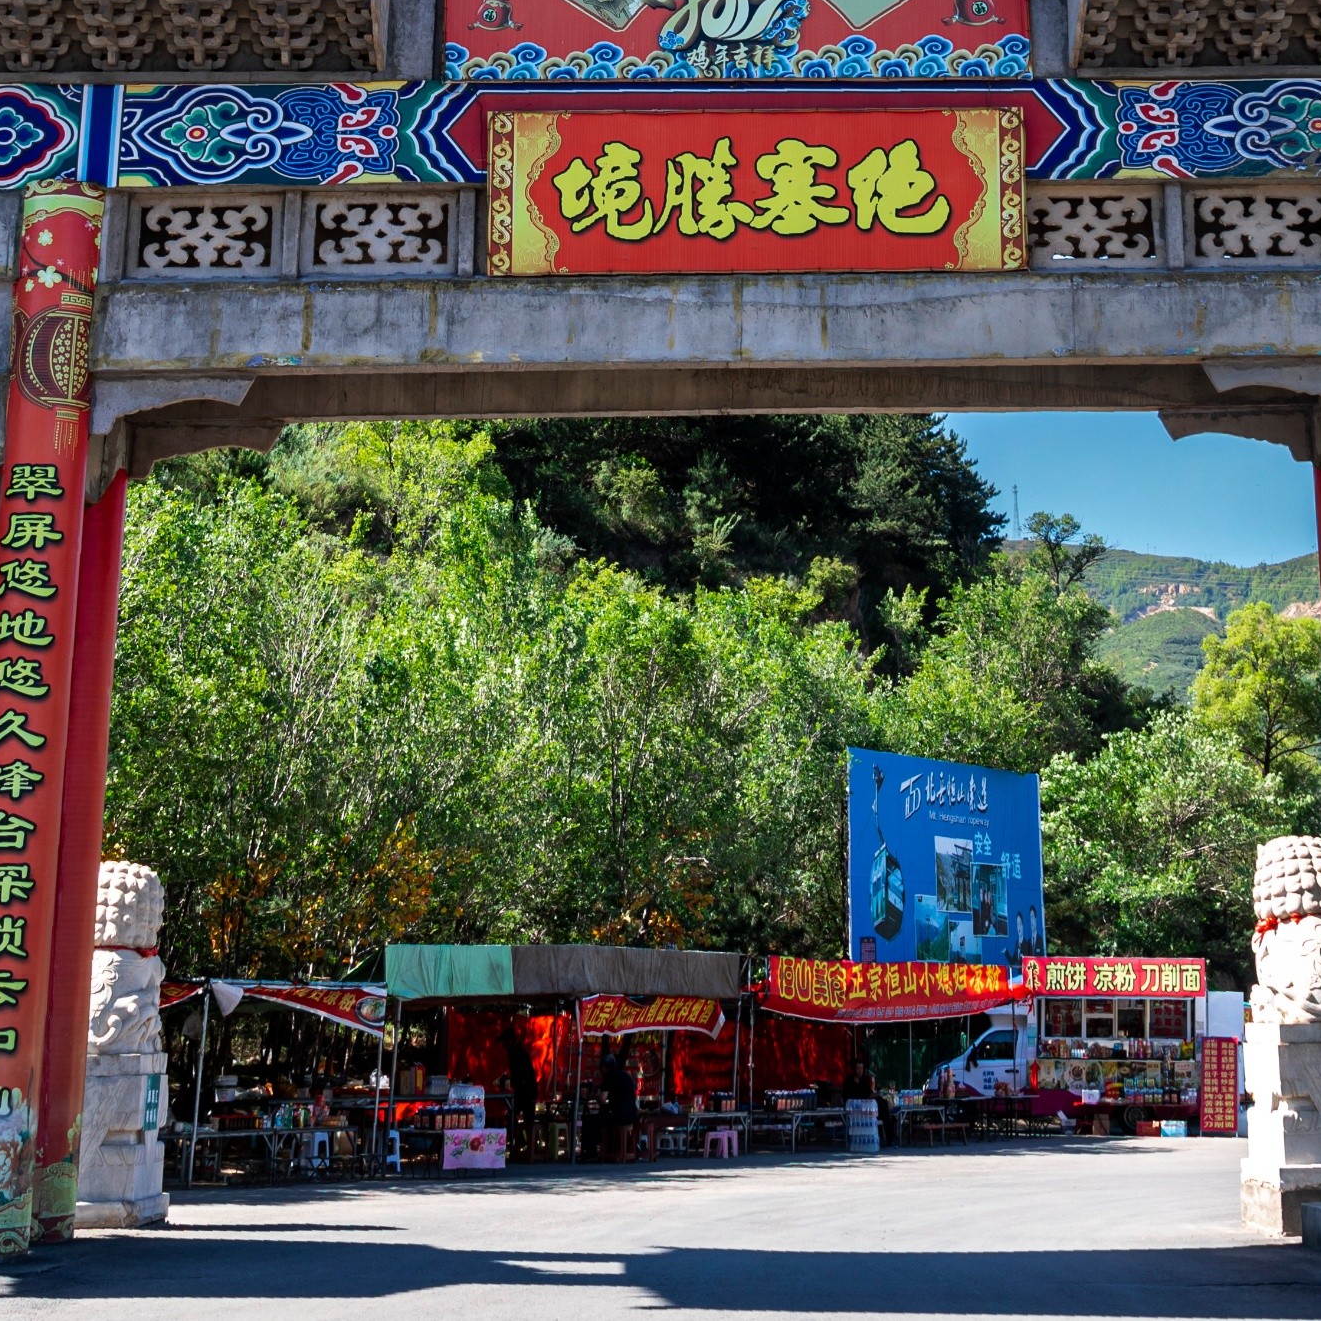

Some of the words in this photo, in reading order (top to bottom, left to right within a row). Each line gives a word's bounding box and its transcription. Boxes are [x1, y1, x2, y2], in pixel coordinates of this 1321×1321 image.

[686, 40, 777, 70] 鸡年吉祥
[939, 812, 966, 825] Hengshan
[974, 831, 992, 856] 安全
[1000, 851, 1022, 879] 舒适
[1045, 961, 1087, 992] 煎饼
[1093, 961, 1137, 993] 凉粉
[1140, 963, 1202, 993] 刀削面
